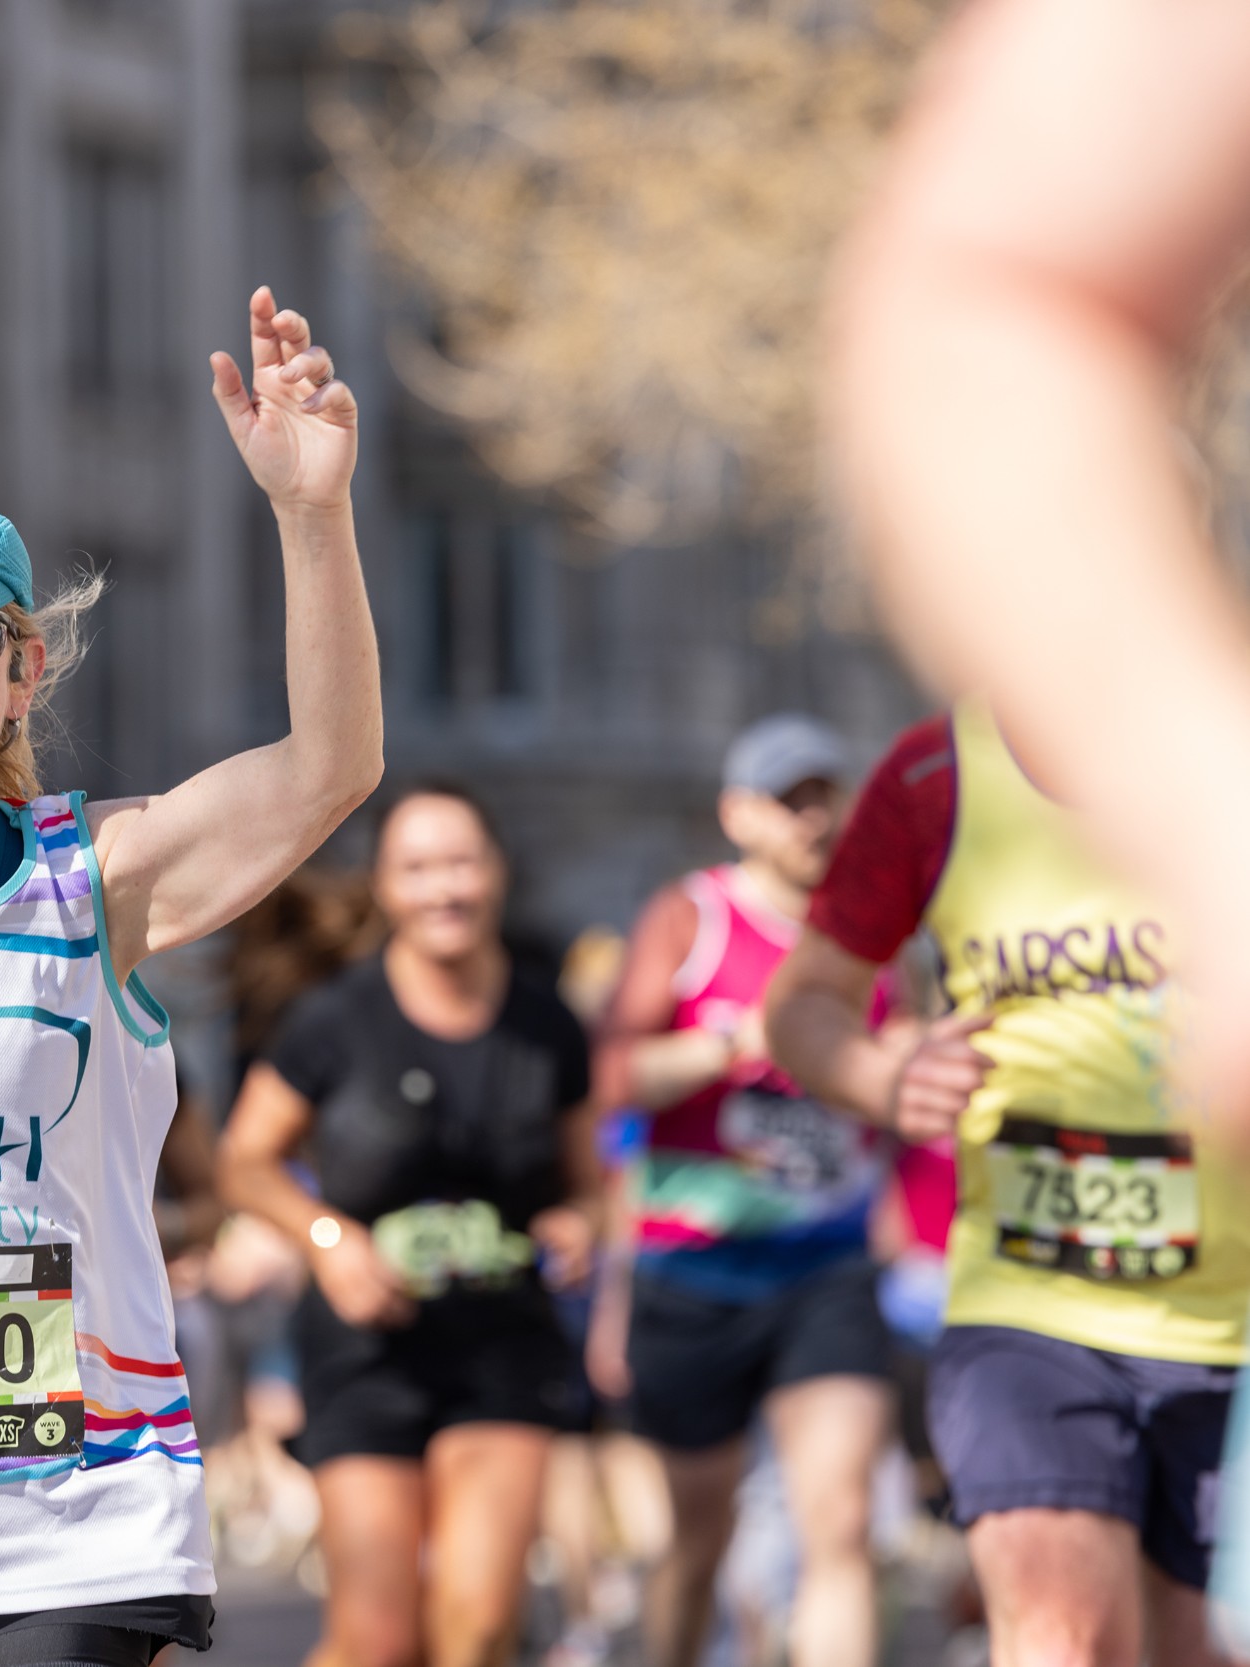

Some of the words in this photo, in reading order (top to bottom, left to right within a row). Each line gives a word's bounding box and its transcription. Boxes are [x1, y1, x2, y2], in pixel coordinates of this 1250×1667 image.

[1018, 1163, 1158, 1225] 7523
[0, 1423, 15, 1443] XS
[46, 1429, 55, 1441] 3
